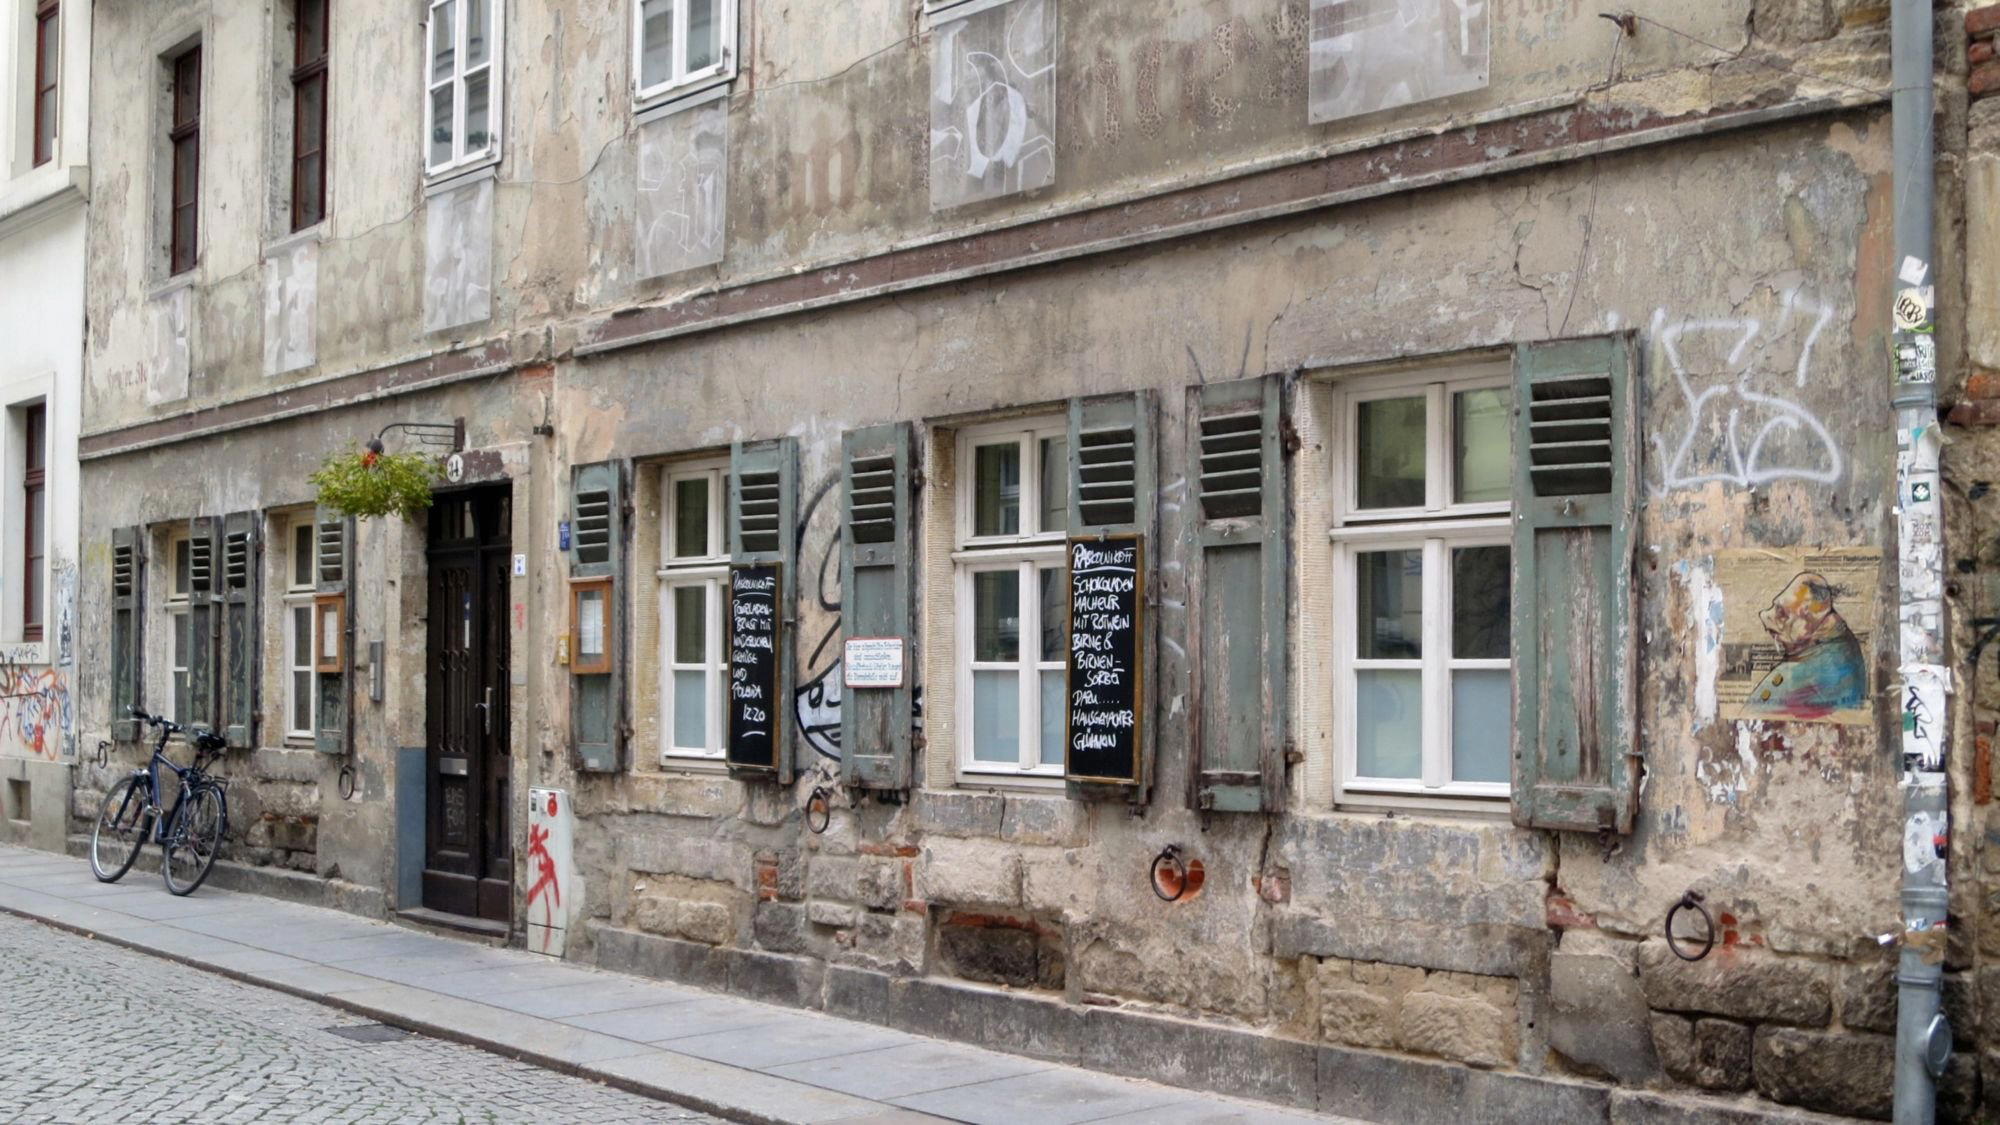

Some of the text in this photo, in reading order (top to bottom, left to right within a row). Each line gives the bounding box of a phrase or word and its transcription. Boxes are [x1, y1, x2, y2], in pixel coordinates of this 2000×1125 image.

[1073, 614, 1090, 630] MIT
[1071, 631, 1113, 651] BIRNE &
[1074, 650, 1122, 669] BIRNEN-
